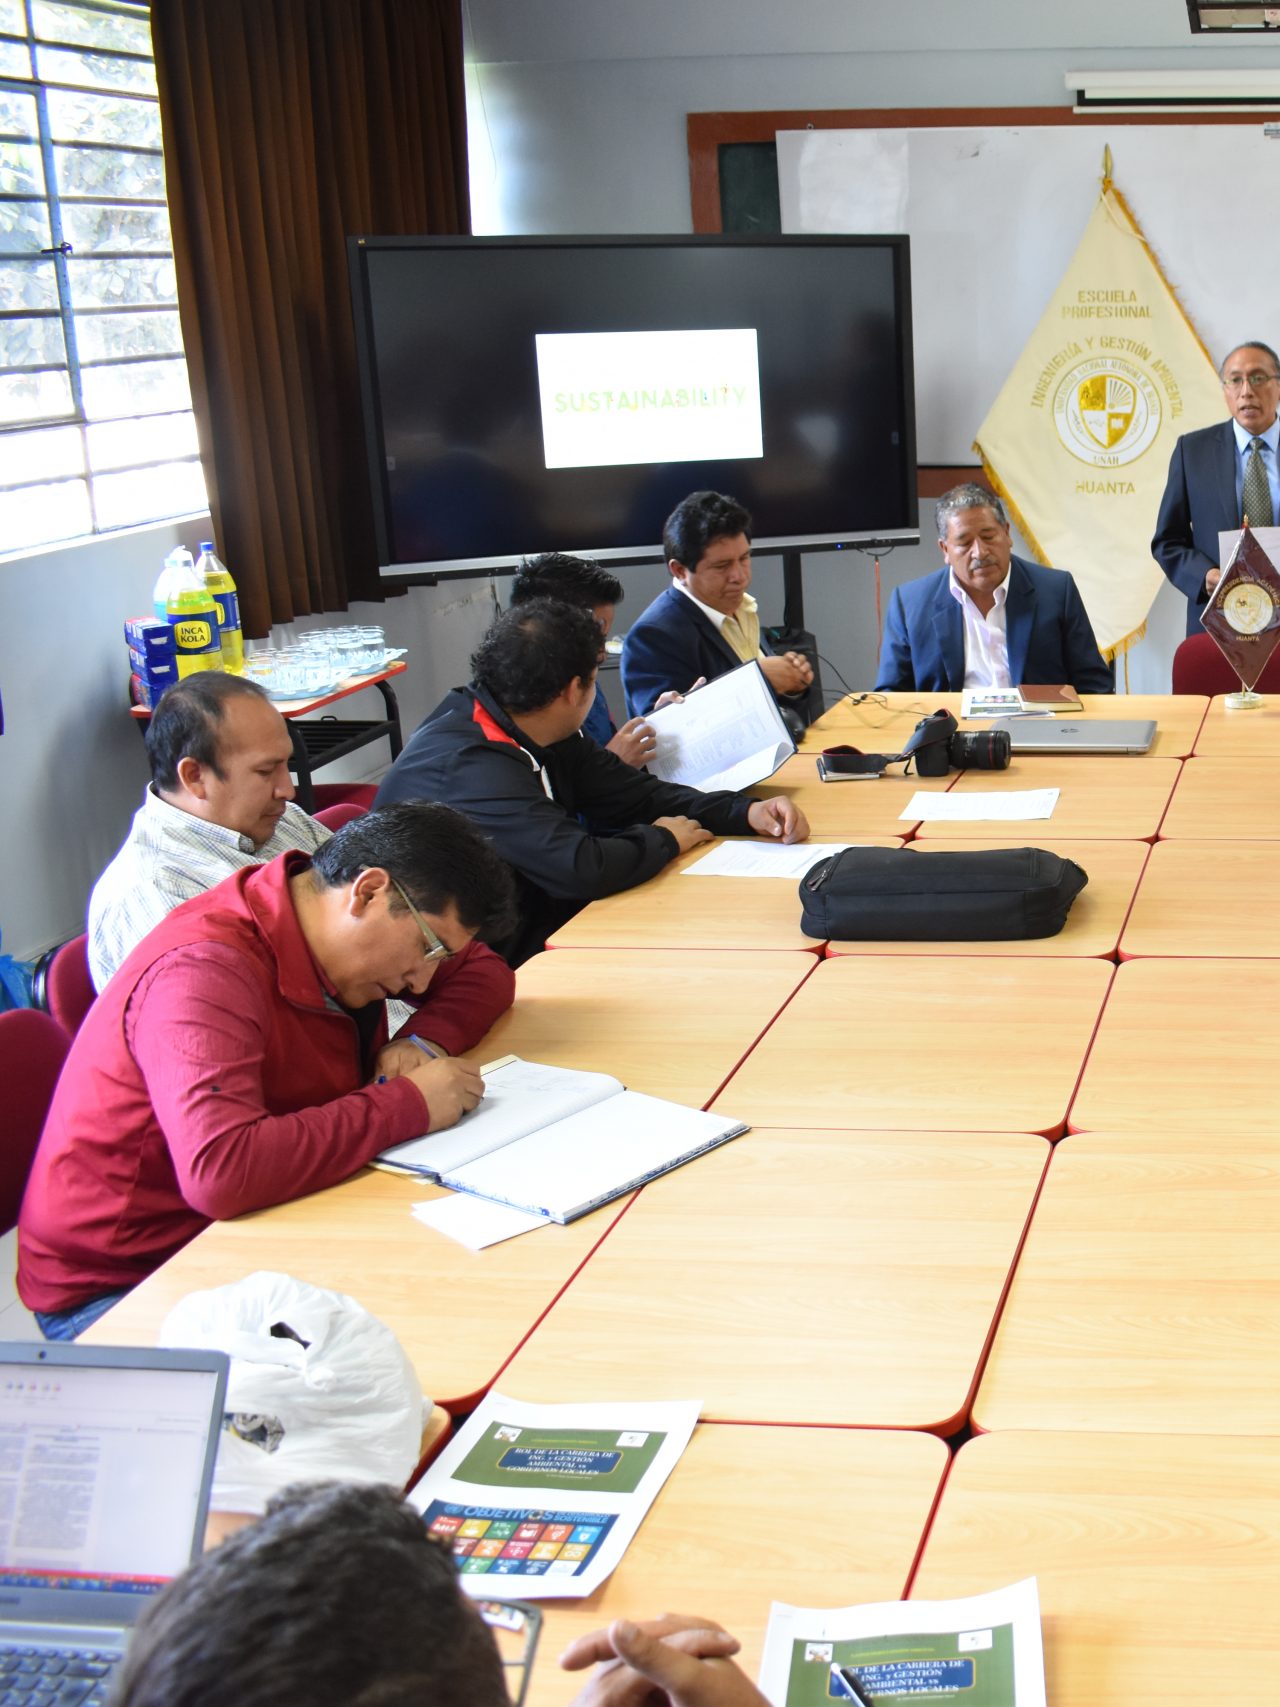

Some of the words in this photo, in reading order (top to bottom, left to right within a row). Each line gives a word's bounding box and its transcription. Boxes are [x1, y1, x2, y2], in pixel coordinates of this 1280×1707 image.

[1078, 290, 1137, 303] ESCUELA
[1062, 305, 1153, 319] PROFESIONAL
[1085, 337, 1094, 351] Y
[1100, 336, 1153, 362] GESTIÓN
[1151, 358, 1185, 420] AMBIENTAL
[554, 386, 747, 413] SUSTAINABILITY
[1093, 455, 1119, 465] UNAH
[1075, 481, 1136, 494] HUANTA
[180, 635, 206, 643] KOLA
[552, 1455, 593, 1463] GESTIÓN
[463, 1507, 554, 1521] OBJETIVOS
[864, 1665, 880, 1674] DE
[882, 1664, 896, 1672] LA
[897, 1662, 946, 1671] CARRERA
[949, 1660, 965, 1668] DE
[861, 1674, 884, 1682] ING.
[892, 1668, 942, 1678] GESTIÓN
[864, 1678, 927, 1690] AMBIENTAL
[910, 1685, 959, 1693] LOCALES
